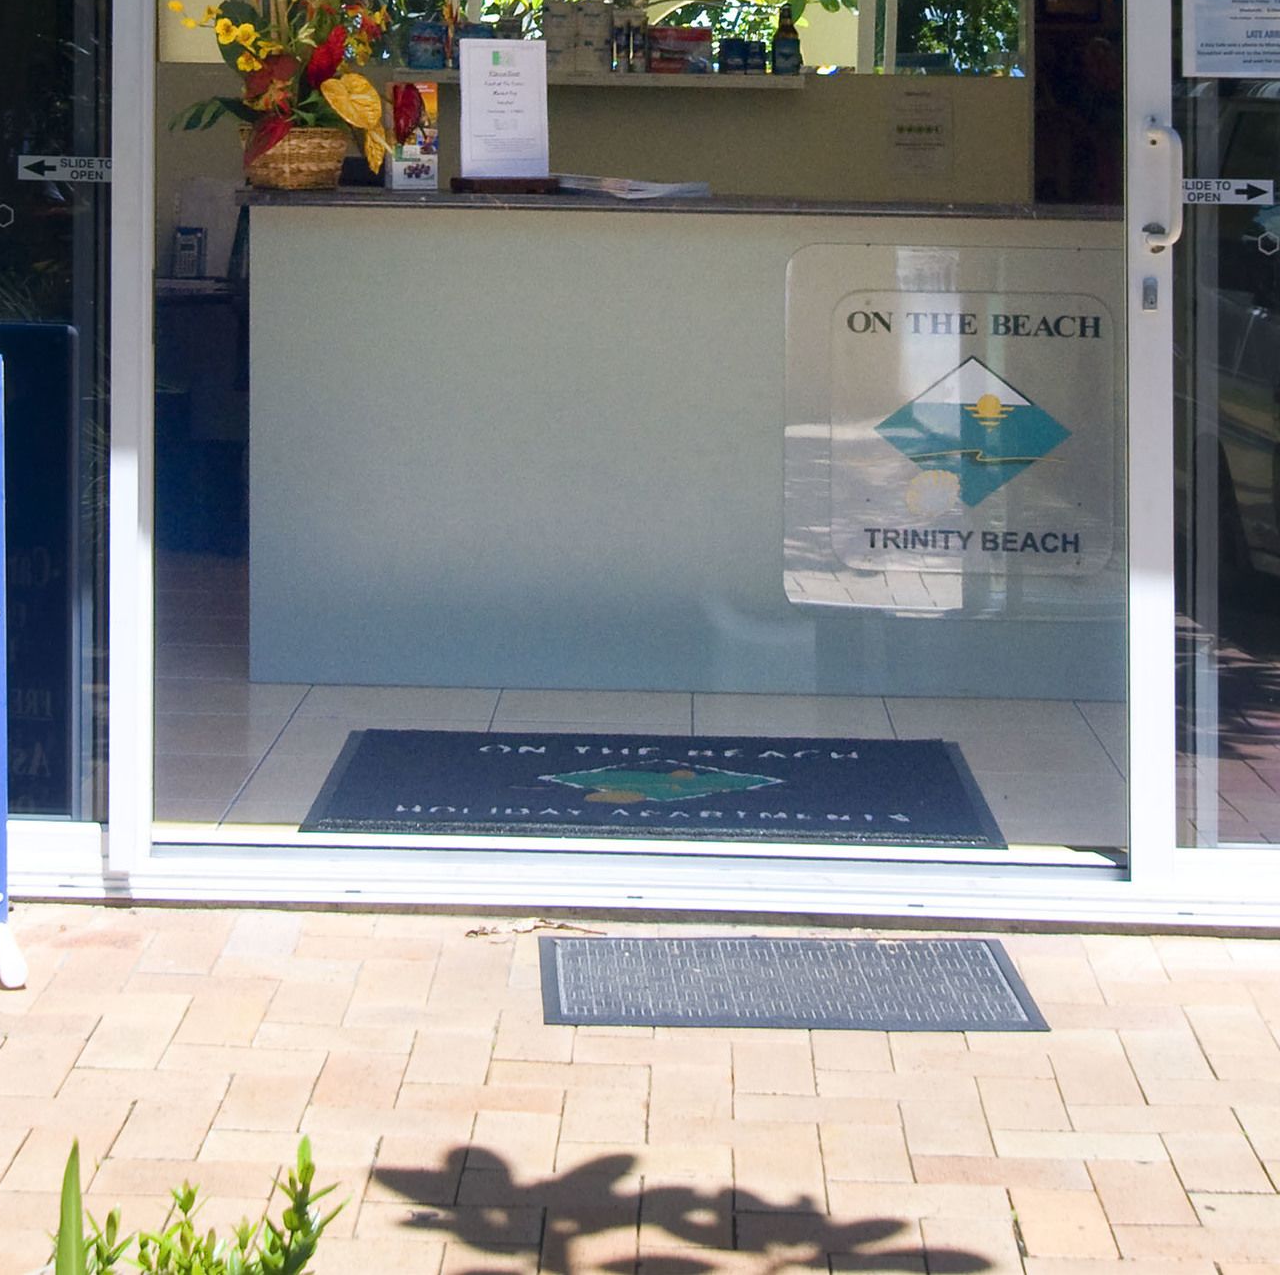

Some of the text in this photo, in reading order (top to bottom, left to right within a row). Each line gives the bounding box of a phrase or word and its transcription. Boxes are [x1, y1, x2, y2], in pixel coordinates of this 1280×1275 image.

[59, 158, 94, 168] SLIDE
[70, 170, 104, 180] OPEN
[1215, 181, 1231, 191] TO
[1187, 192, 1221, 202] OPEN
[846, 310, 1102, 339] ON THE BEACH
[864, 527, 1080, 554] TRINITY BEACH
